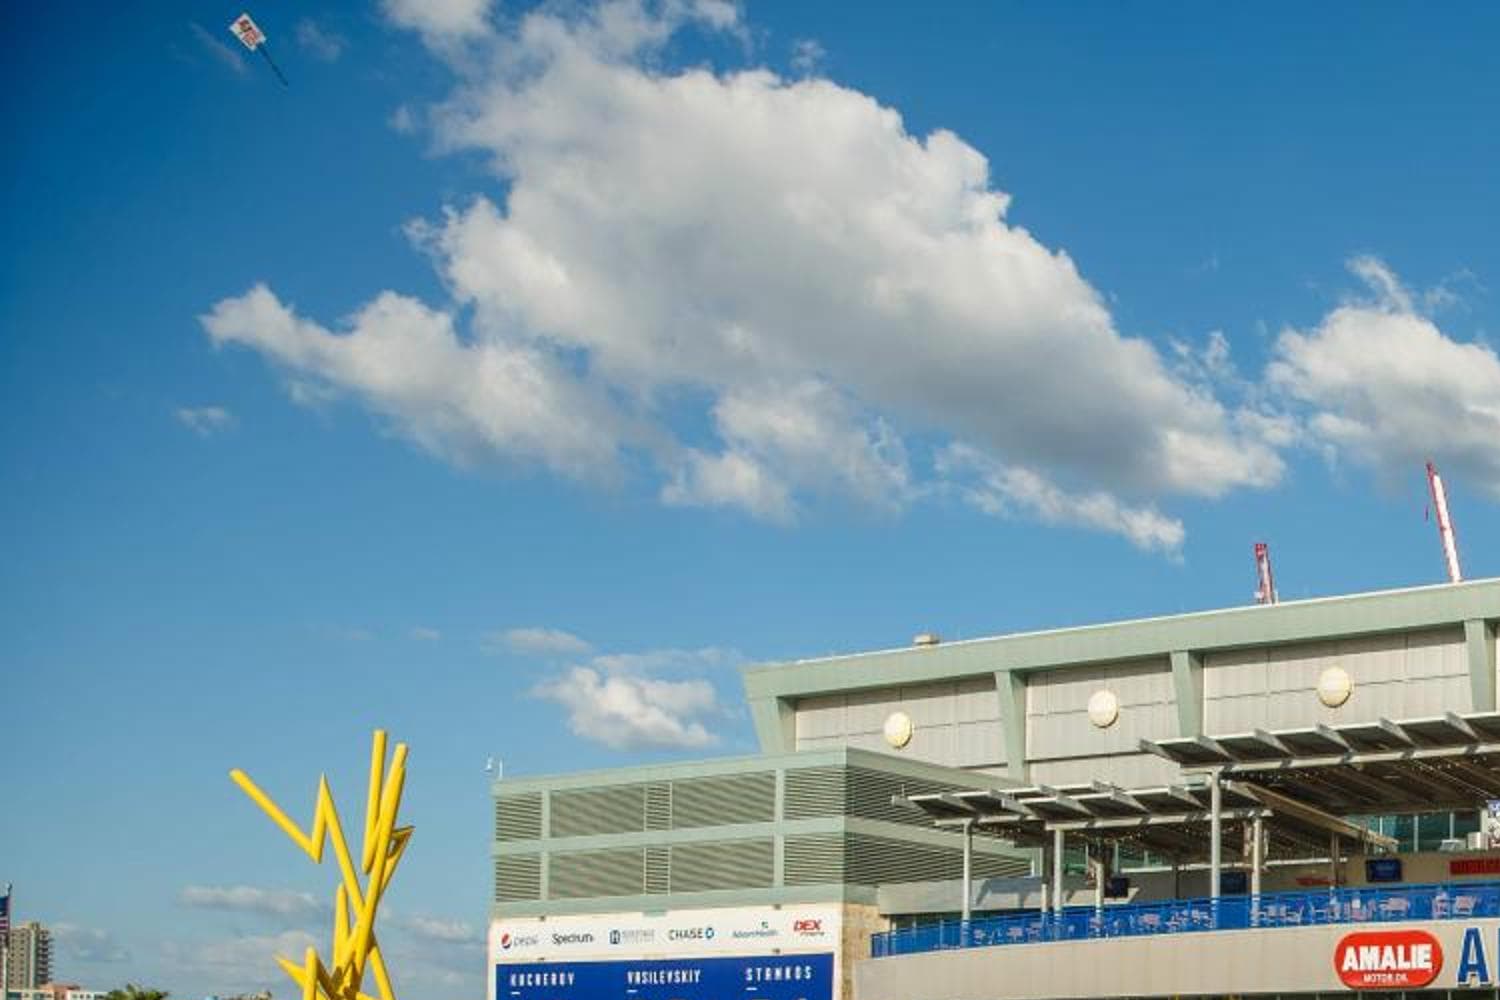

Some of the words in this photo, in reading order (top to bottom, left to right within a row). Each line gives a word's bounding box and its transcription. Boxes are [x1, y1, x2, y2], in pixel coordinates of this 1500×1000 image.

[793, 919, 822, 932] DEX
[551, 932, 594, 946] Spectrum
[669, 927, 704, 941] CHASE
[1341, 943, 1433, 972] AMALIE
[627, 969, 701, 985] VASILEVSKIY
